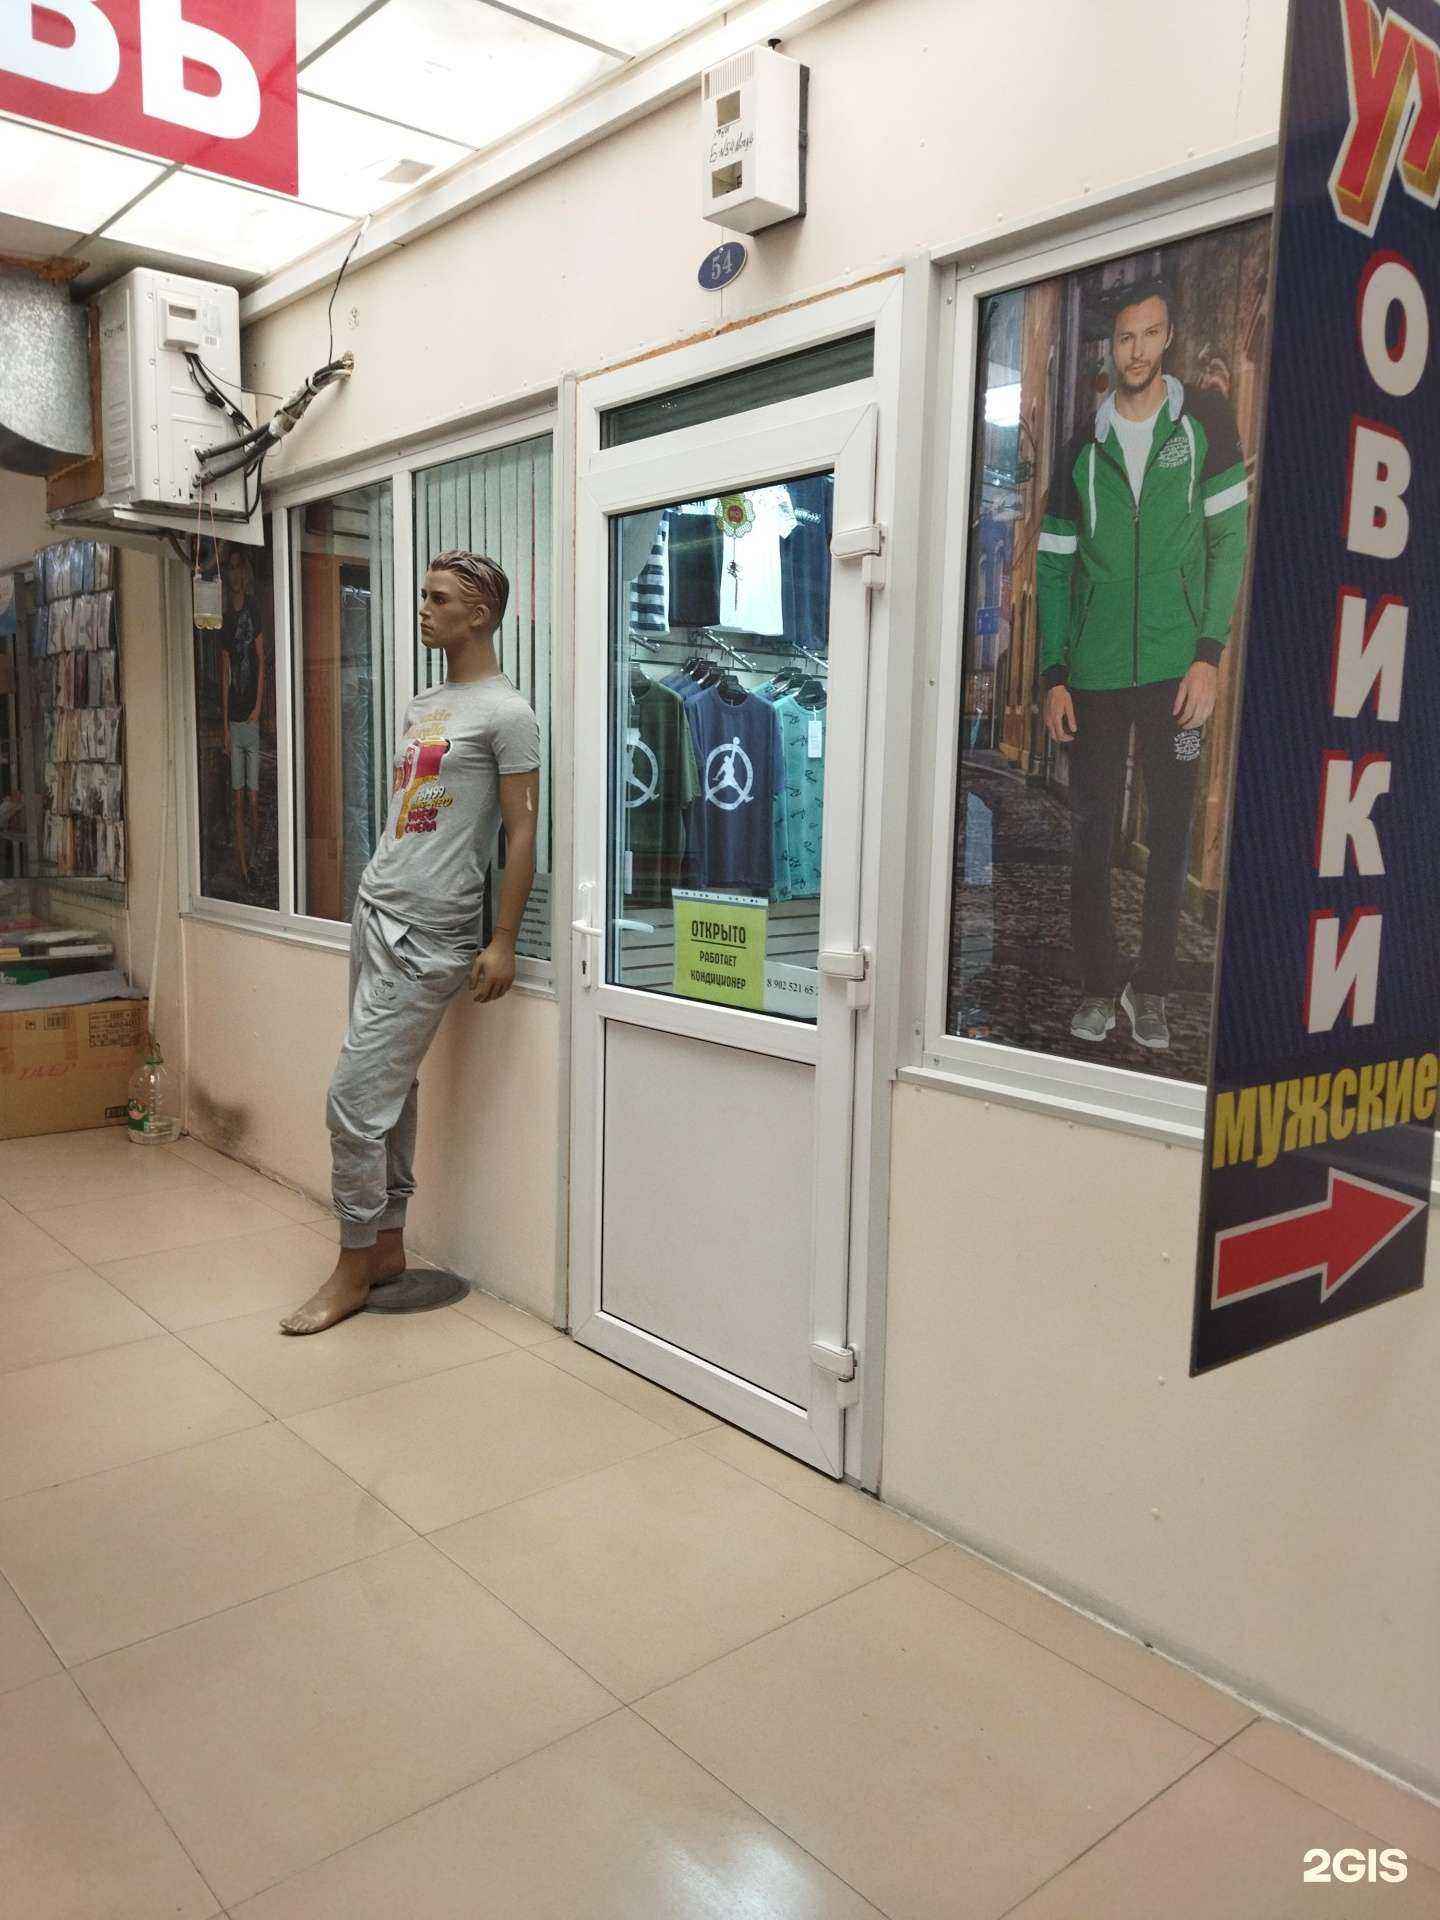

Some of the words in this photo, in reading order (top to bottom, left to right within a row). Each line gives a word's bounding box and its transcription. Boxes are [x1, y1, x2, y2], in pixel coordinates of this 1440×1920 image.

[711, 249, 733, 280] 54
[691, 920, 746, 944] ОТКРЫТО
[699, 950, 737, 967] РАБОТАЕТ
[690, 969, 746, 990] КОНДИЦИОНЕР
[766, 978, 772, 988] 8
[773, 979, 786, 990] 902
[788, 981, 802, 993] 521
[804, 984, 814, 996] 65
